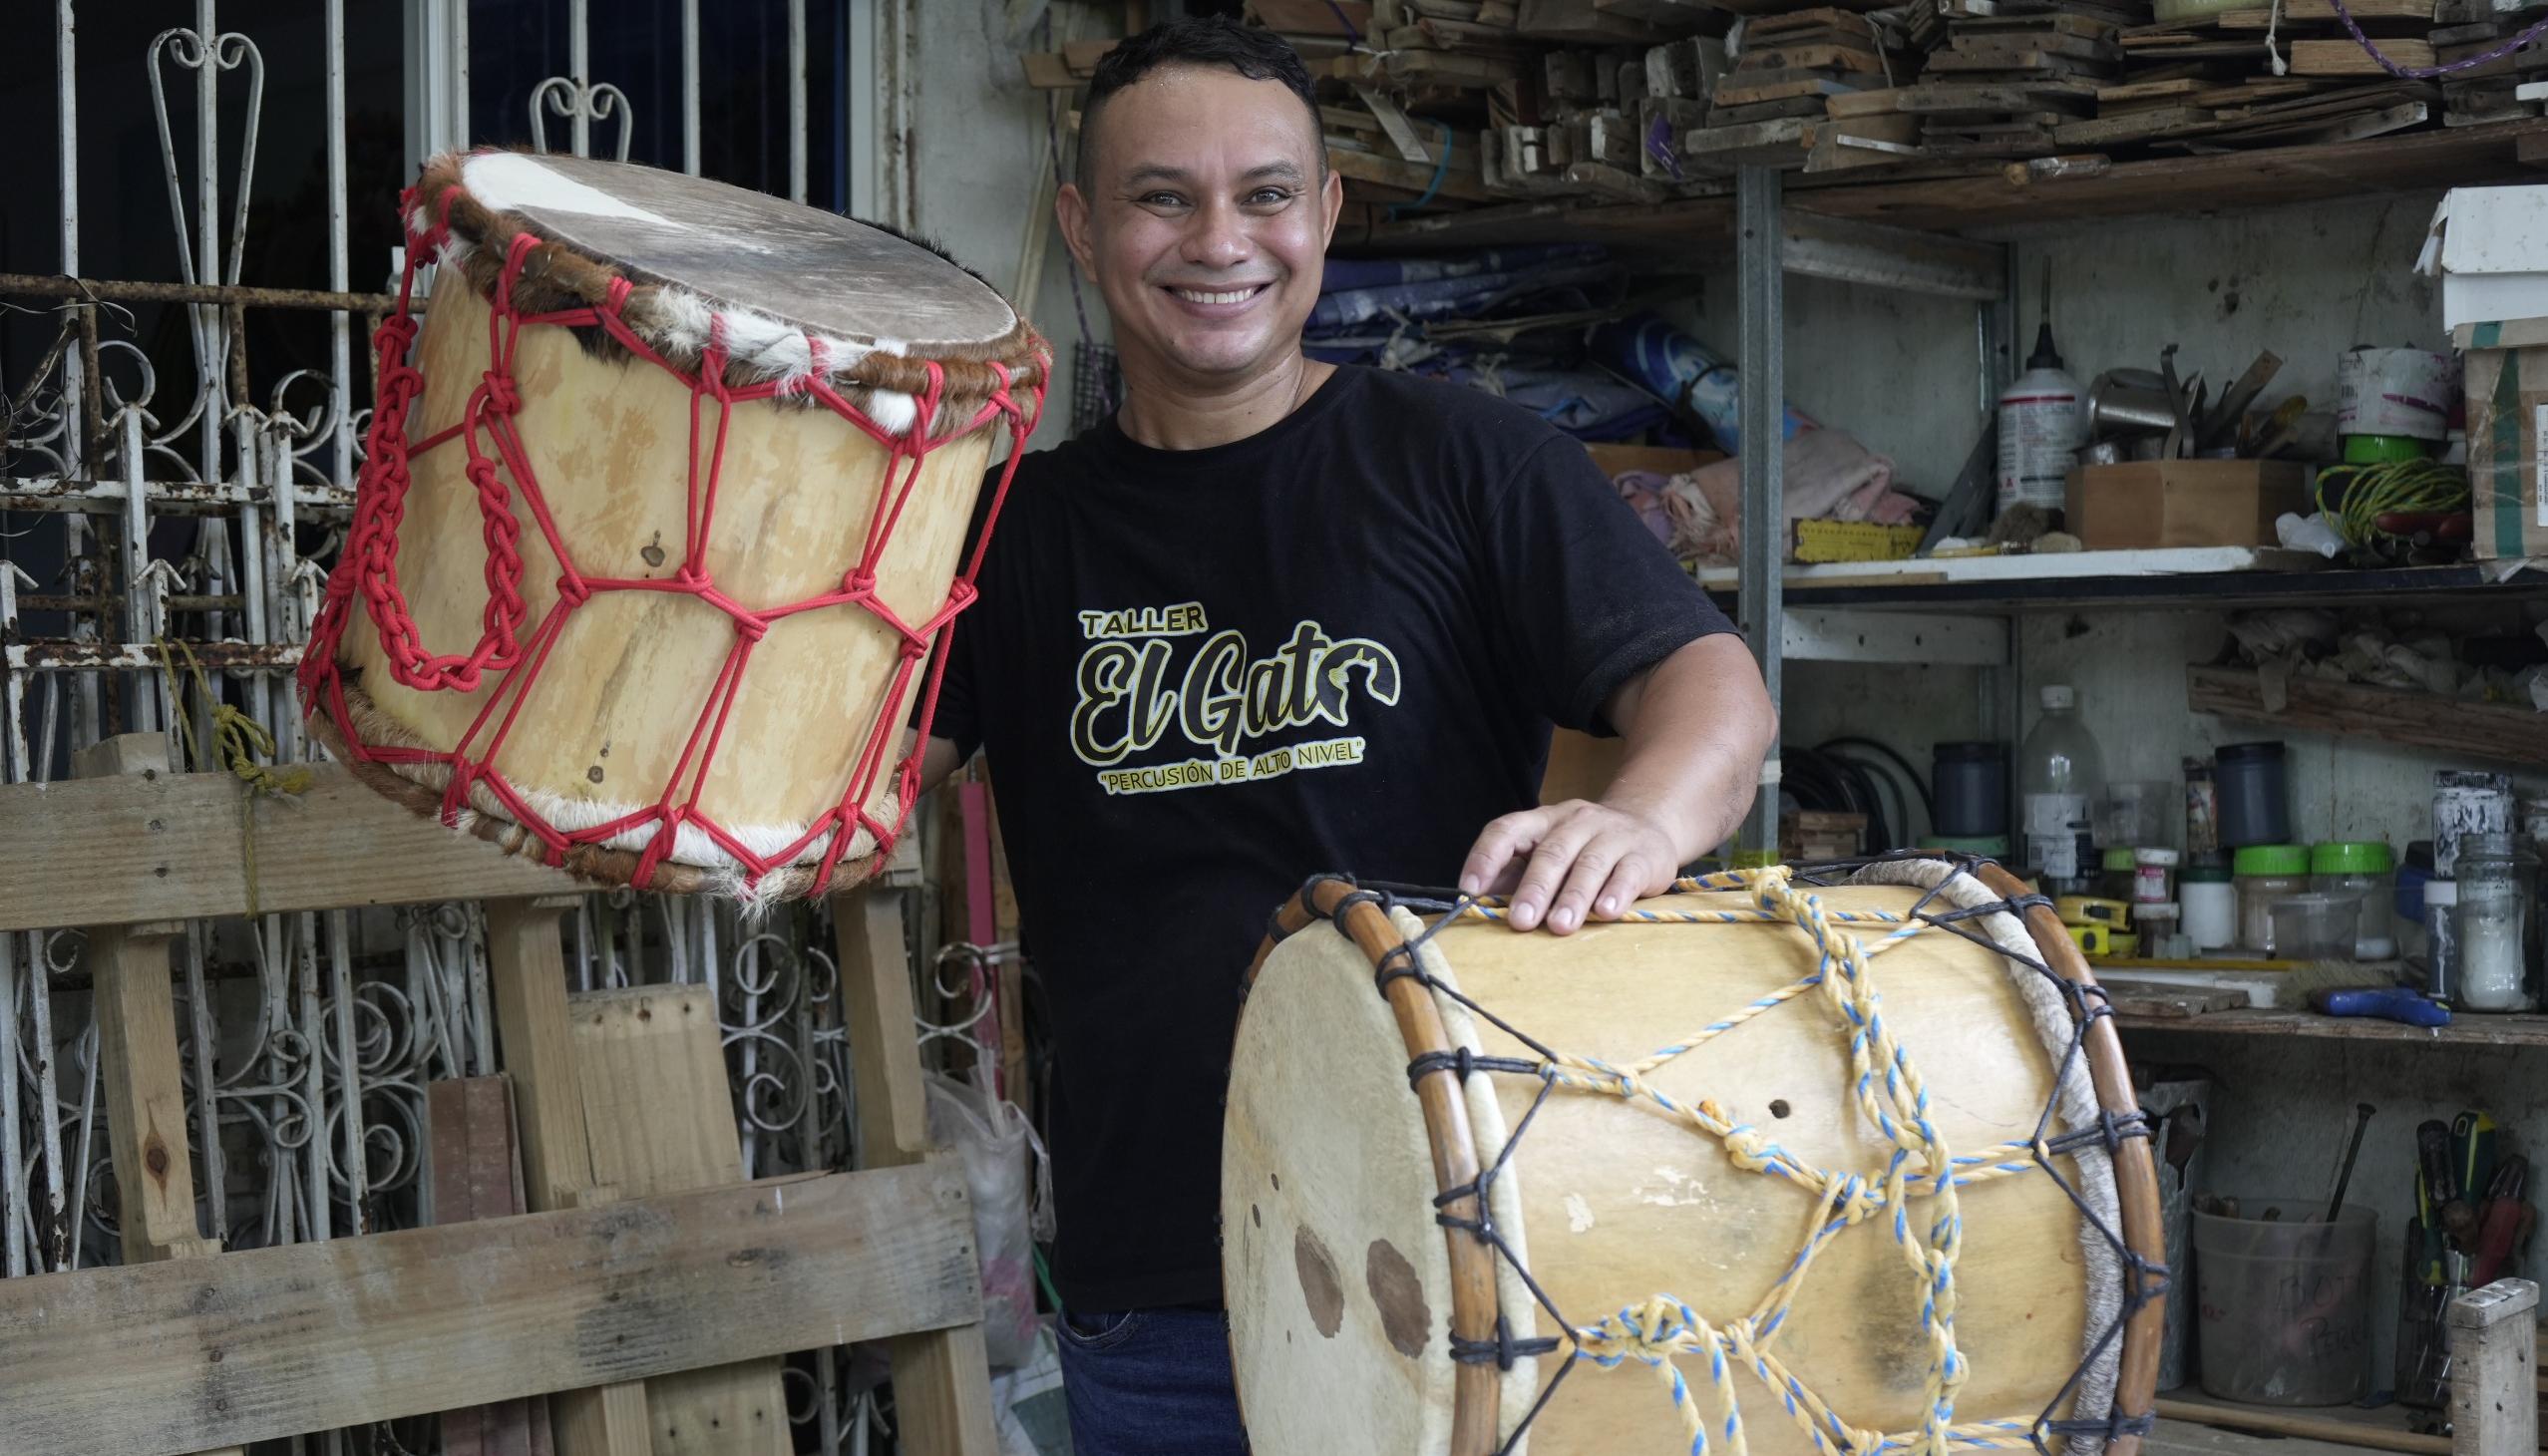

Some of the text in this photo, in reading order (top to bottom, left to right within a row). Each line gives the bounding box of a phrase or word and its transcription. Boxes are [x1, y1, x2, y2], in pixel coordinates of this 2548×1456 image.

[1080, 602, 1207, 636] TALLER
[1072, 639, 1177, 765] El
[1100, 740, 1363, 792] "PERCUSIÓN DE ALTO NIVEL"
